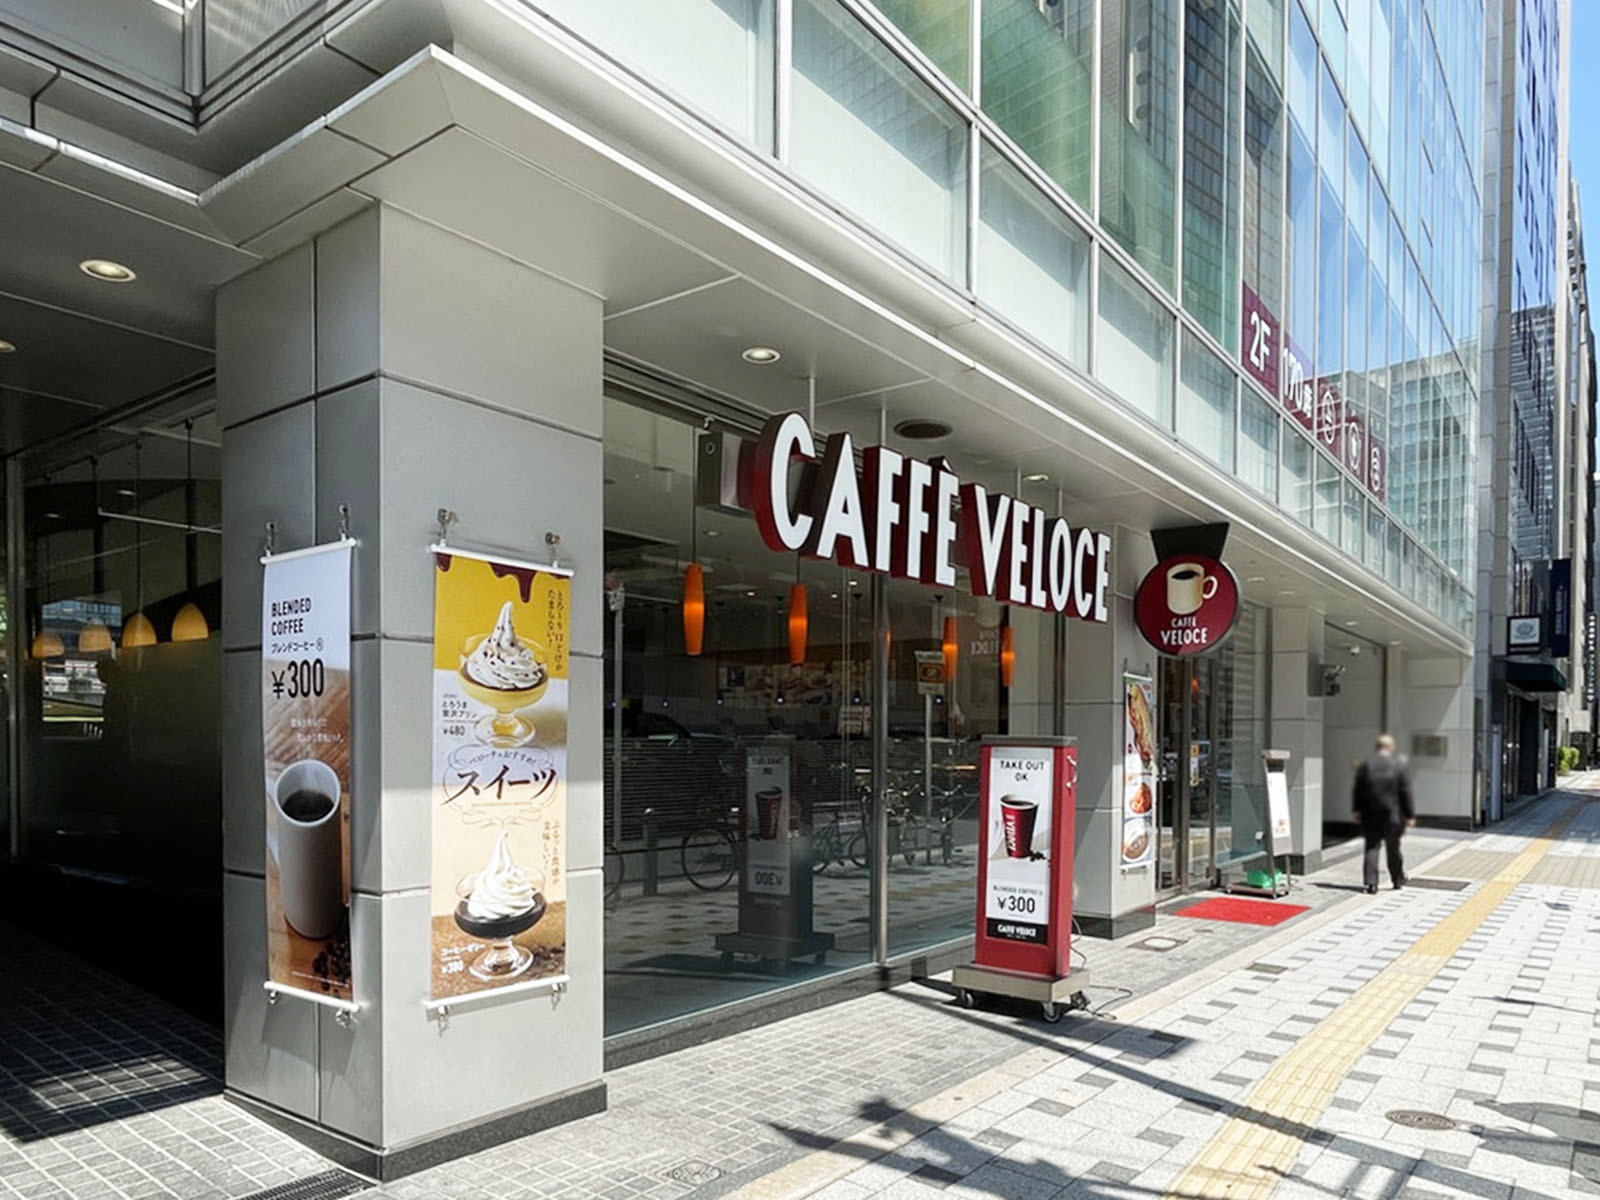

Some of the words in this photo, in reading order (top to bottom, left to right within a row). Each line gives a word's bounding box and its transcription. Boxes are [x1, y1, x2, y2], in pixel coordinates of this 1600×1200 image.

[1250, 310, 1272, 371] 2F
[975, 484, 1111, 622] VELOCE
[272, 597, 312, 617] BLENDED
[272, 618, 304, 636] COFFEE
[1160, 627, 1208, 646] VELOCE
[271, 658, 325, 700] ¥300
[1000, 761, 1023, 770] TAKE
[1025, 761, 1044, 771] OUT
[441, 764, 557, 806] スイーツ
[1014, 772, 1029, 782] OK
[997, 895, 1036, 913] ¥300
